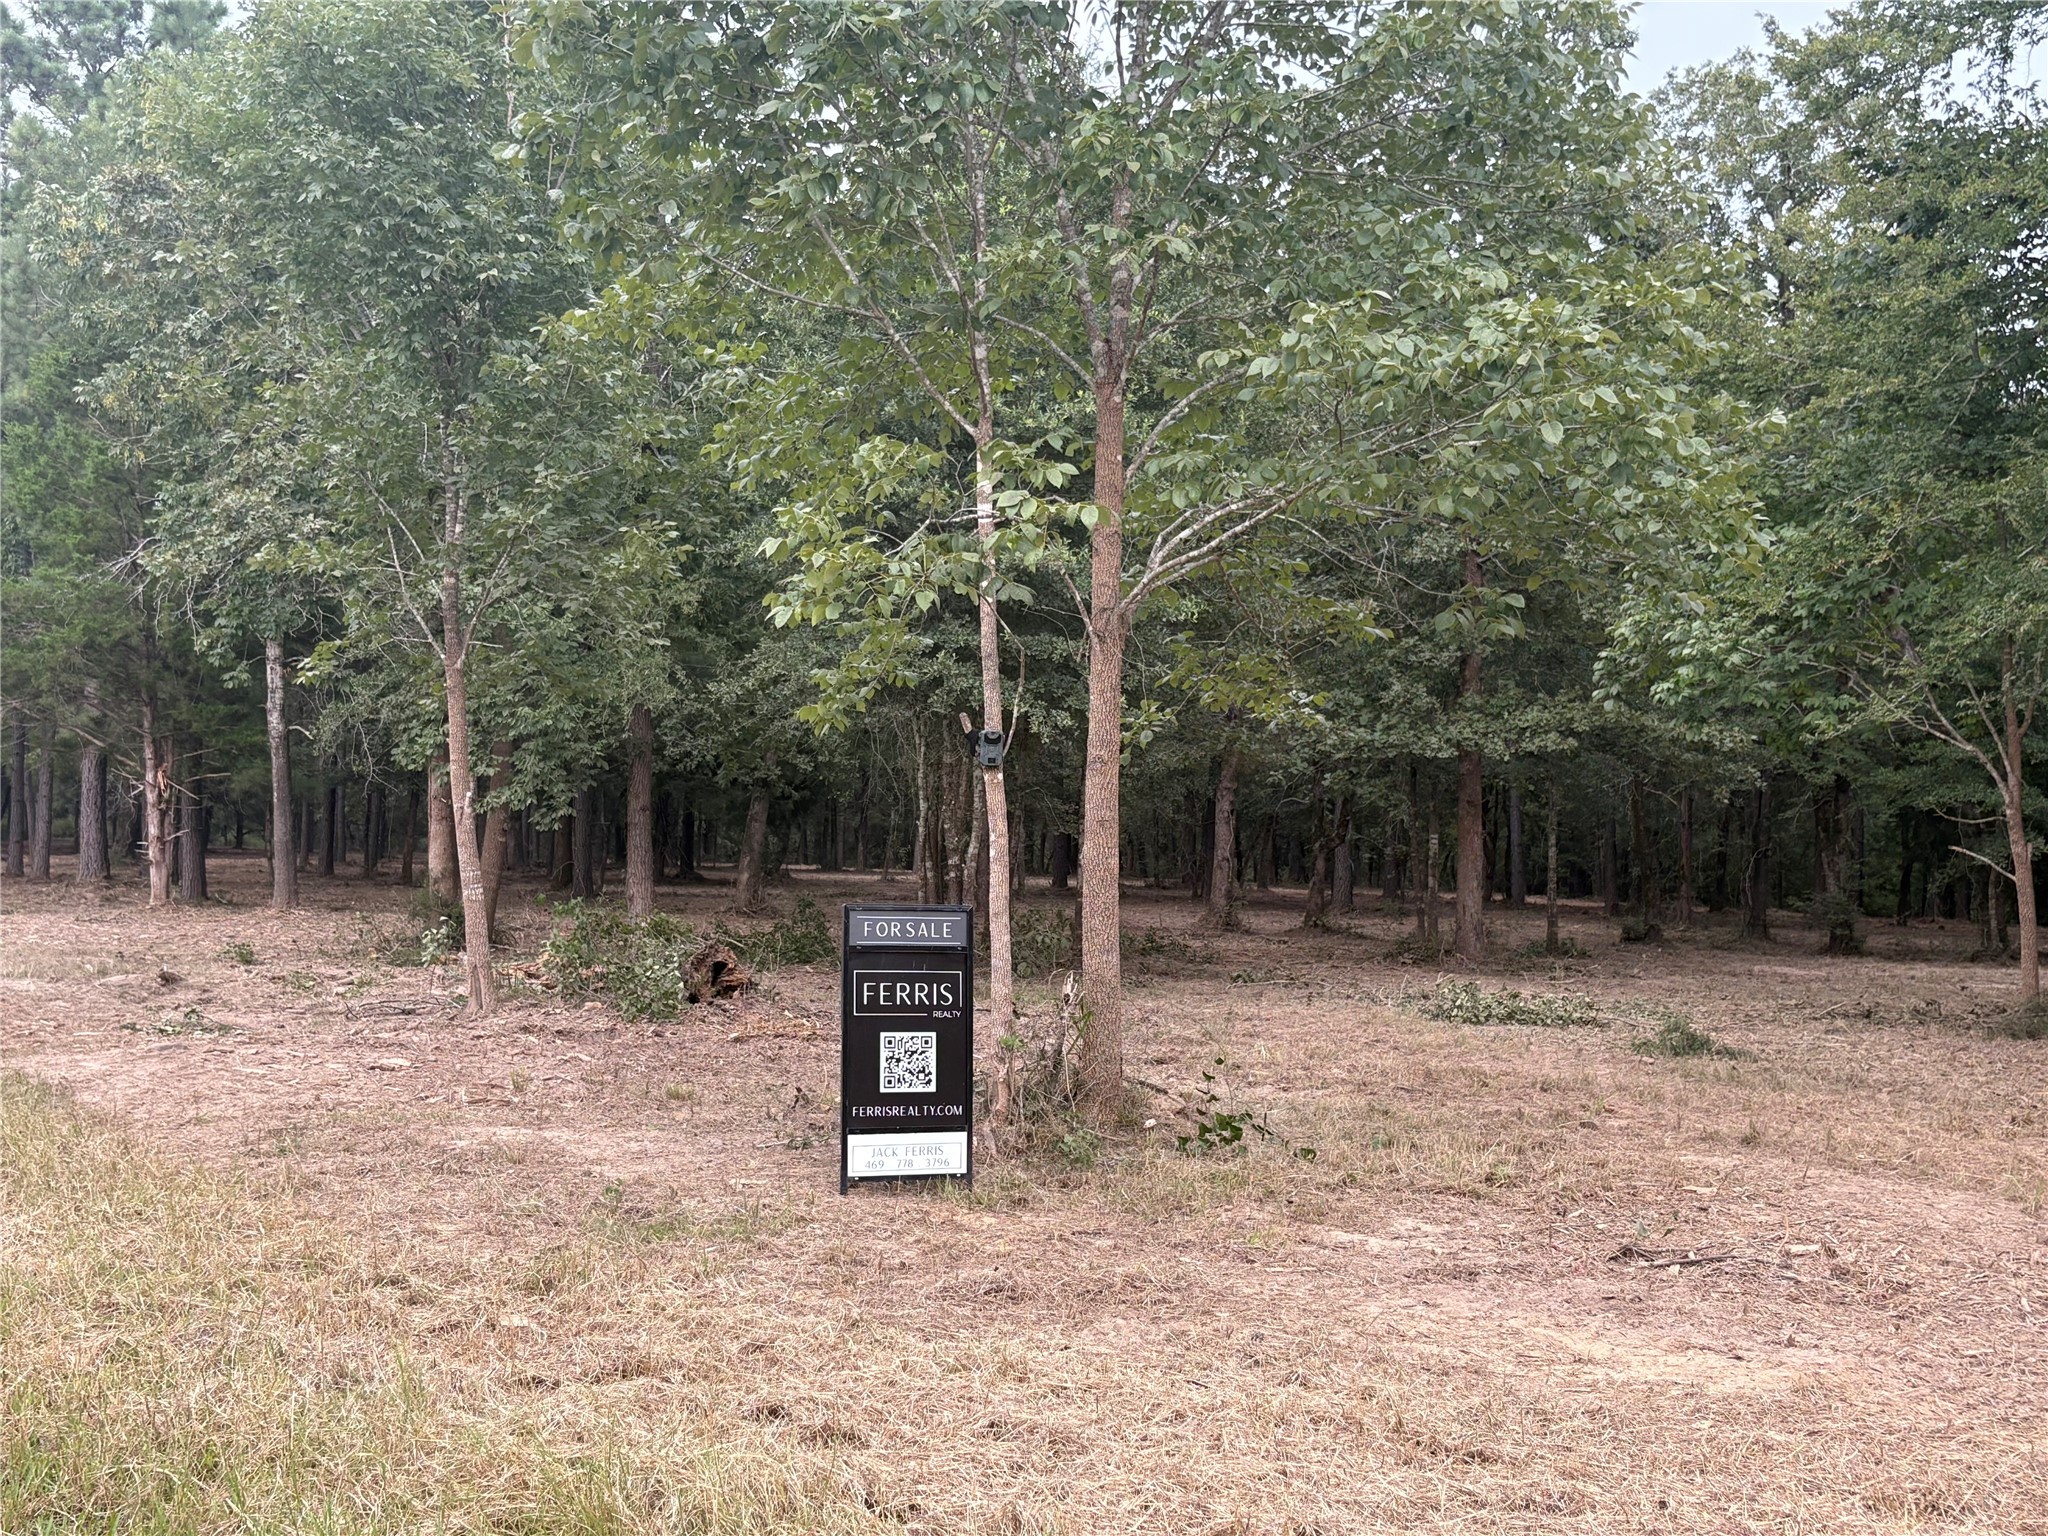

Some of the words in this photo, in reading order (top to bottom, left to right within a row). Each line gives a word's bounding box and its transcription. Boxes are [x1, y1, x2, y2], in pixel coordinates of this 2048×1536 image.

[864, 921, 901, 937] FOR
[906, 922, 953, 938] SALE
[863, 982, 953, 1006] FERRIS
[932, 1010, 962, 1018] REALTY
[852, 1104, 963, 1117] FERRISREALTY.COM
[871, 1147, 898, 1158] JACK
[905, 1145, 944, 1157] FERRIS
[864, 1160, 885, 1169] 469
[896, 1159, 914, 1169] 778
[925, 1158, 950, 1168] 3796
